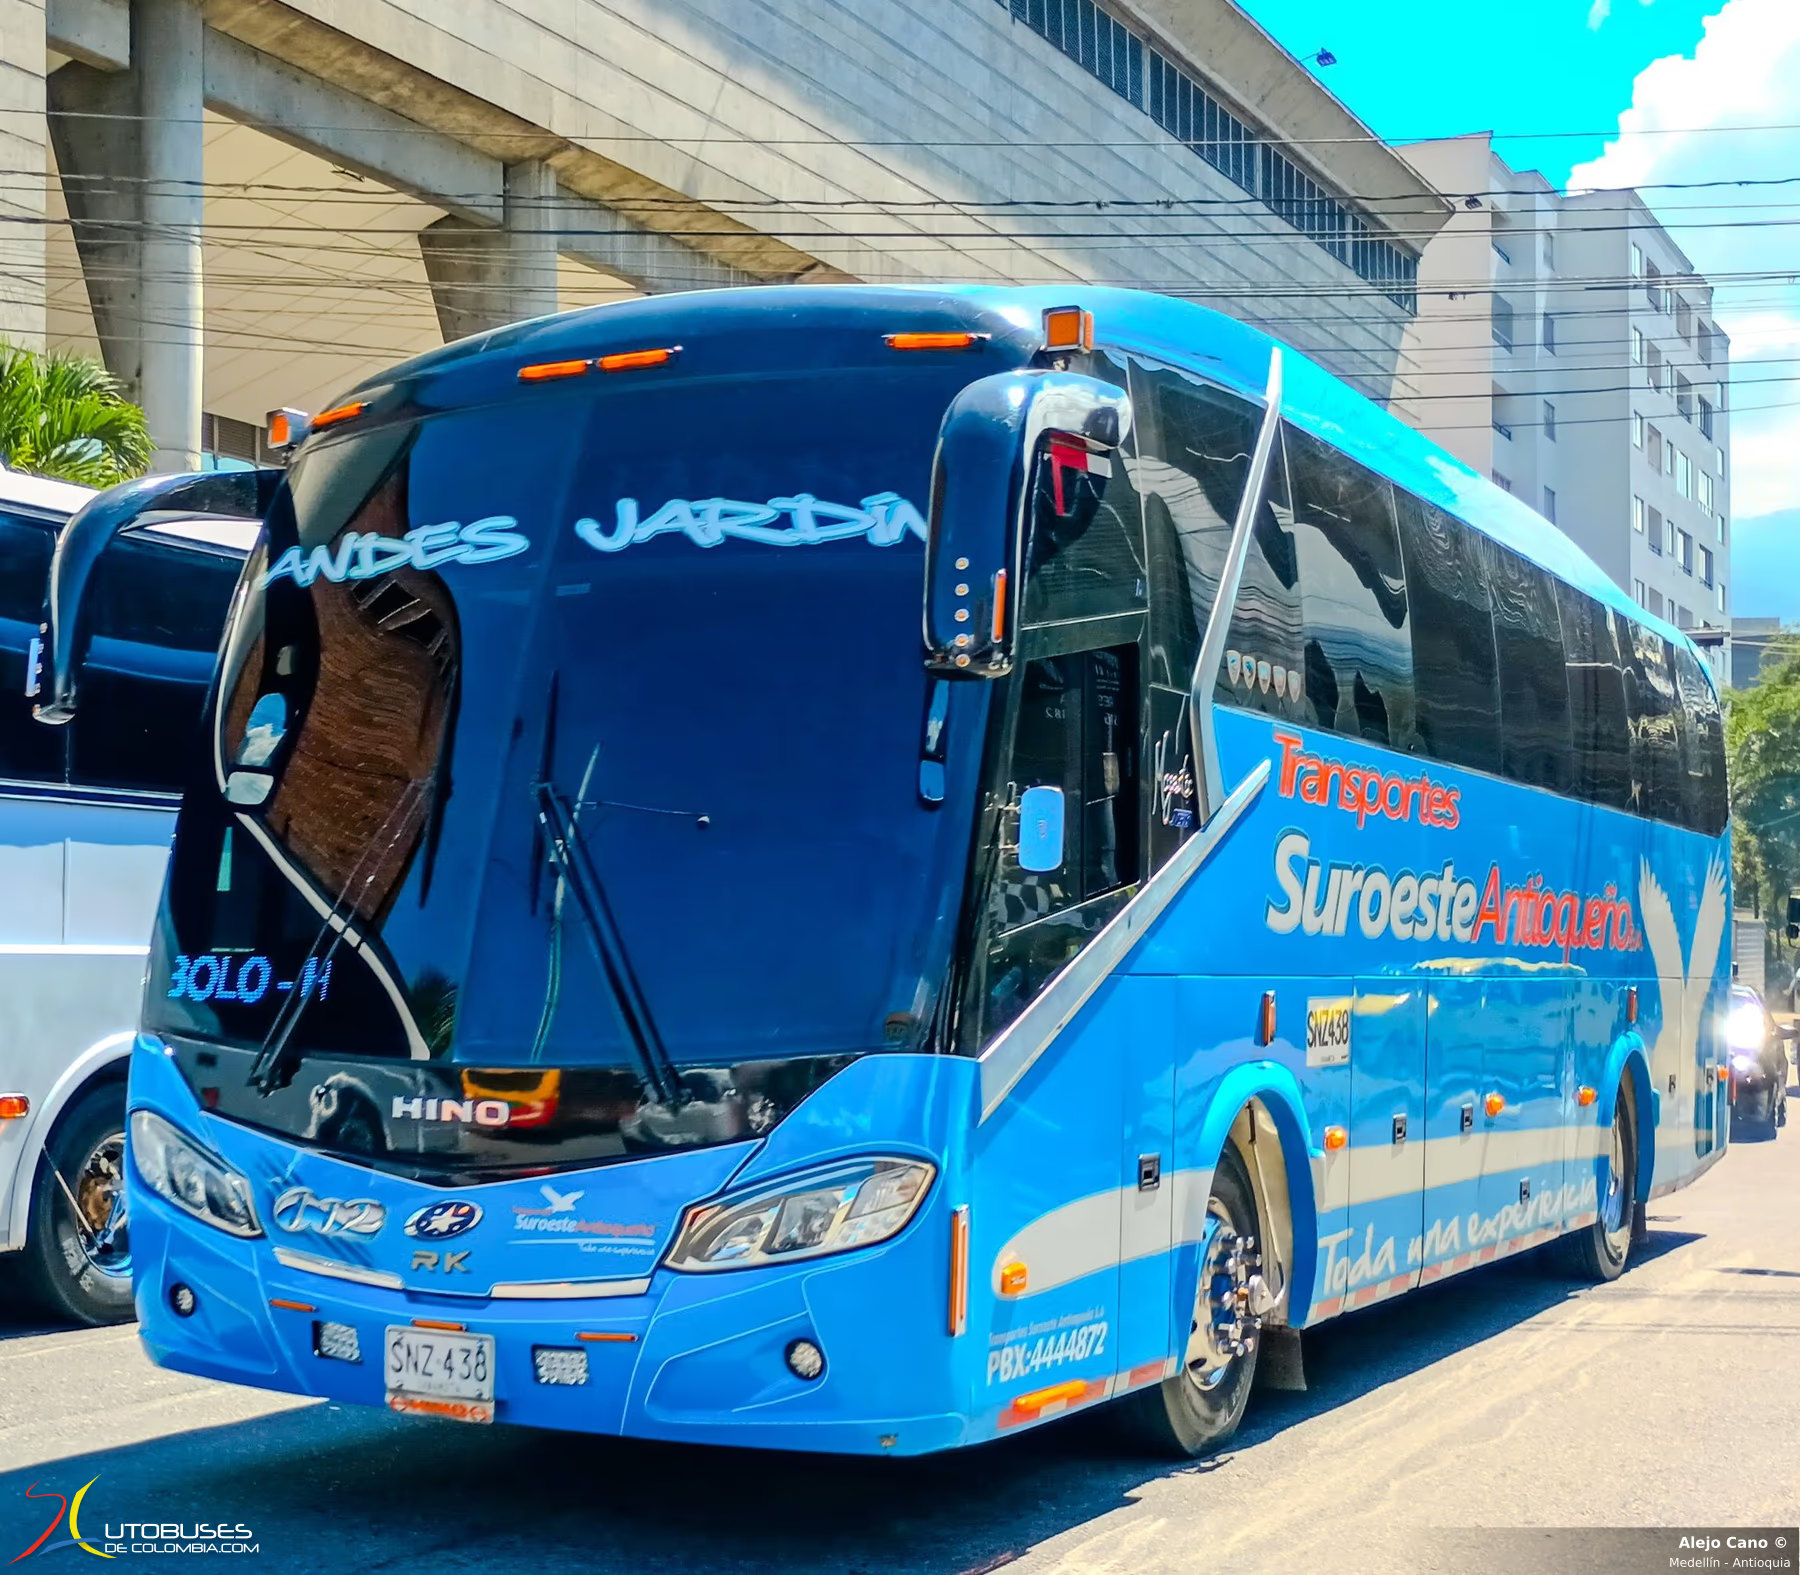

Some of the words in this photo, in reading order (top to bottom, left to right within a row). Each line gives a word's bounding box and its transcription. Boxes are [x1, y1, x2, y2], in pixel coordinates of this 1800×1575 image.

[261, 515, 531, 589] ANDES
[1274, 730, 1461, 829] Transportes
[1307, 1009, 1349, 1048] SNZ438
[391, 1096, 510, 1127] HINO
[1317, 1222, 1396, 1296] Toda
[1407, 1215, 1460, 1265] una
[1467, 1168, 1598, 1248] experiencia
